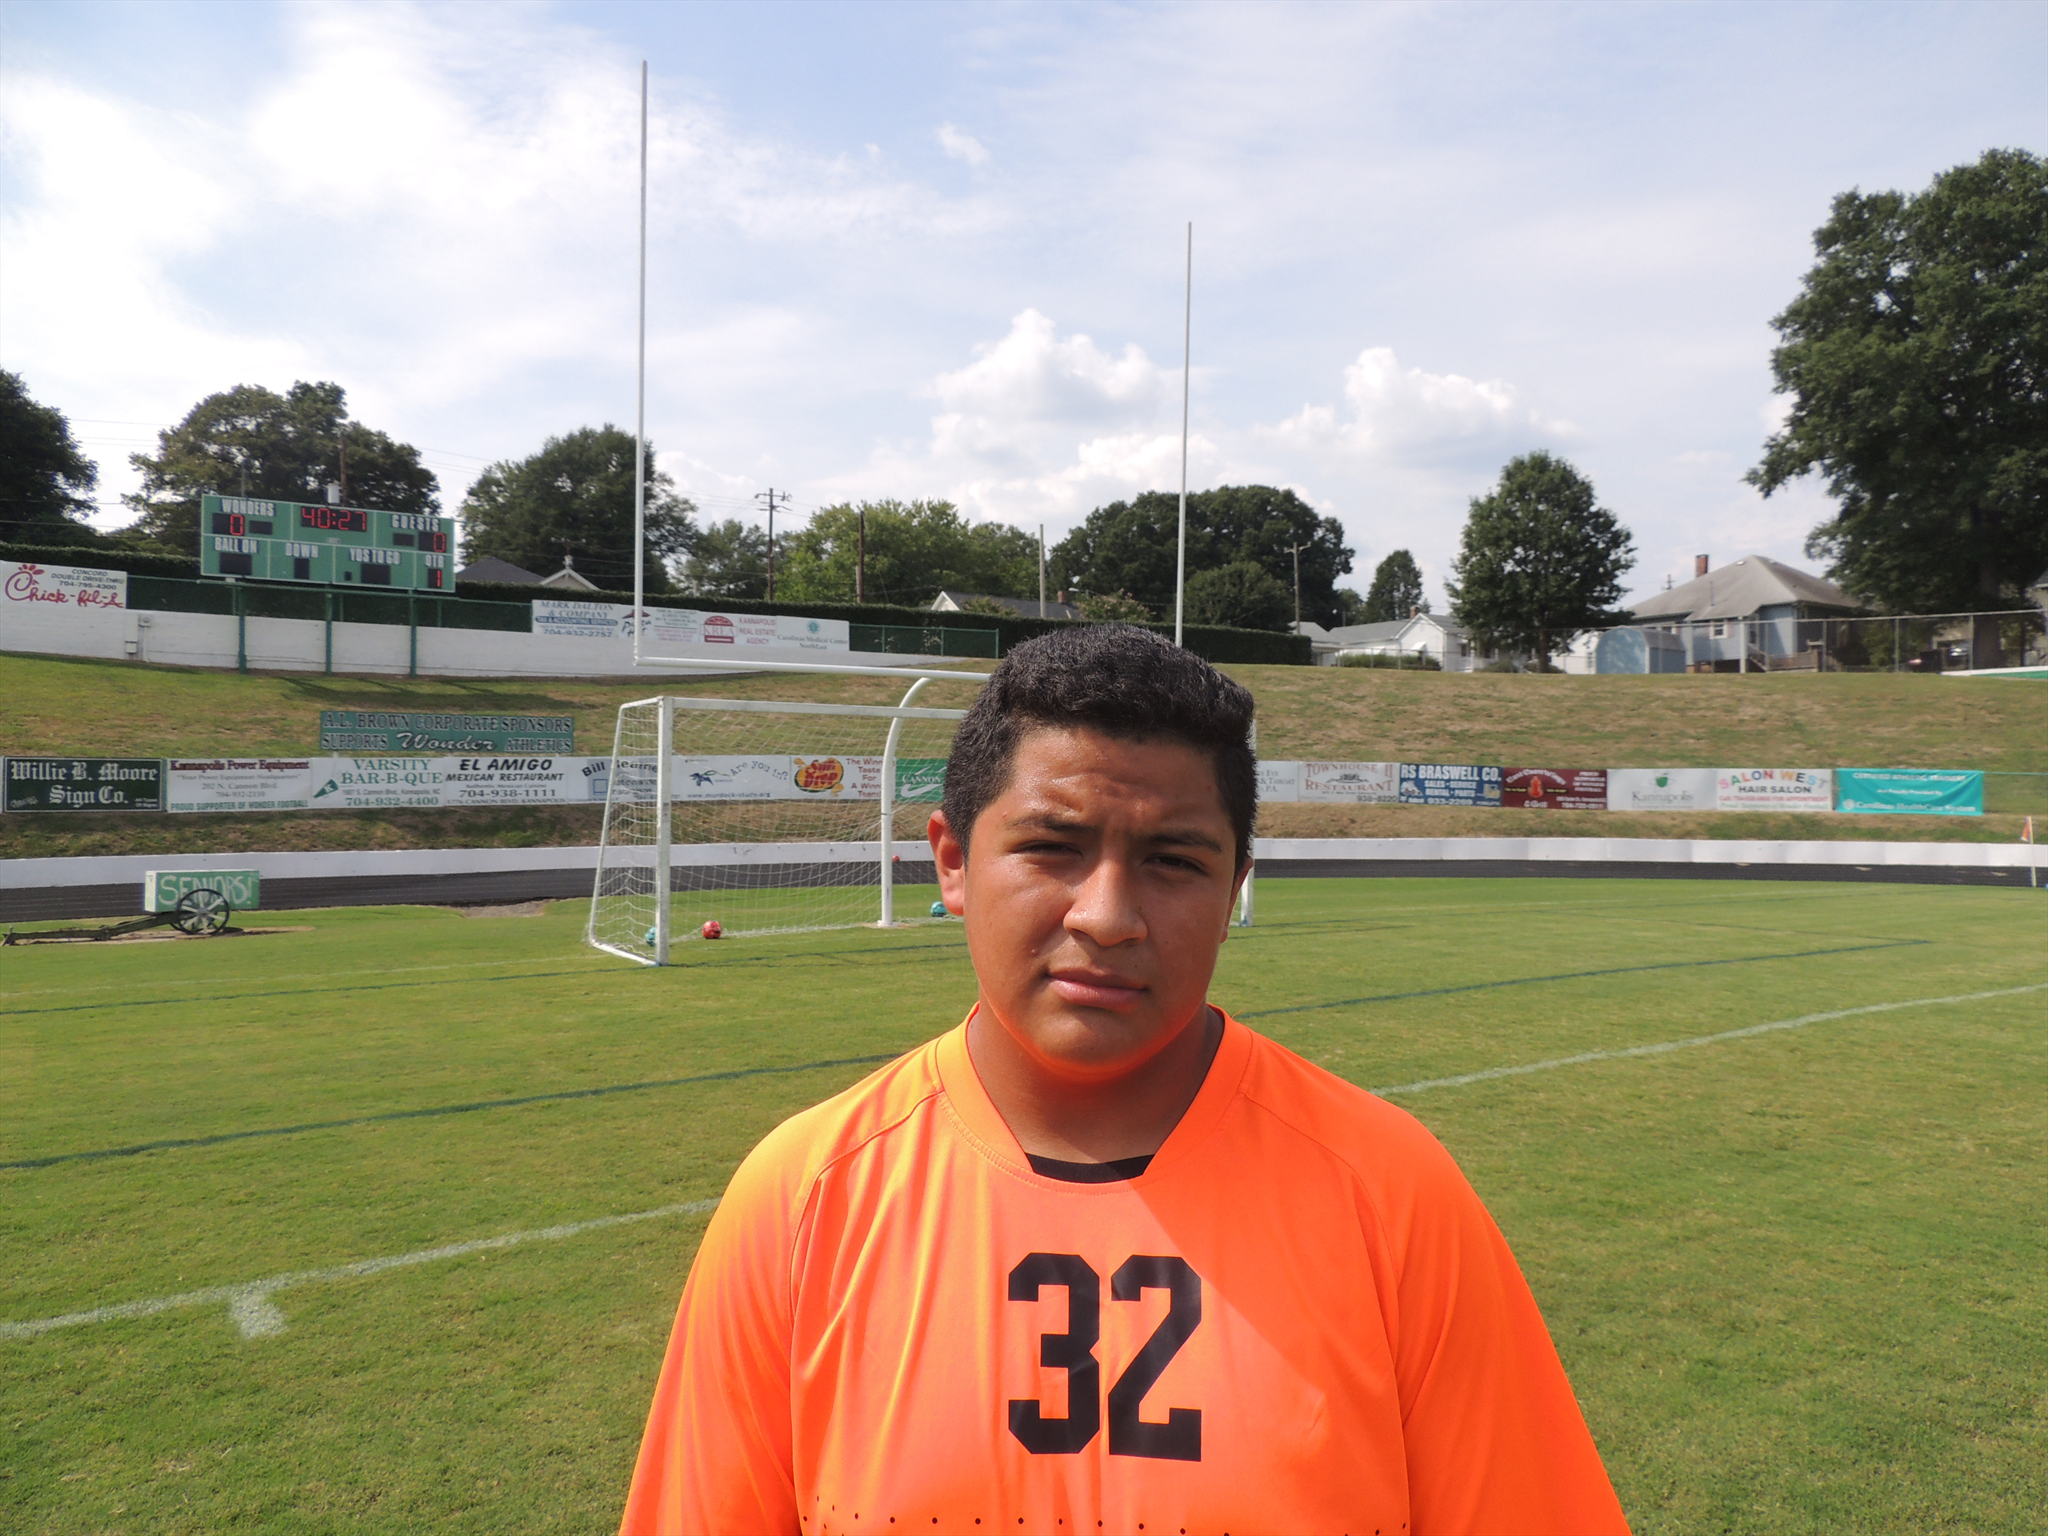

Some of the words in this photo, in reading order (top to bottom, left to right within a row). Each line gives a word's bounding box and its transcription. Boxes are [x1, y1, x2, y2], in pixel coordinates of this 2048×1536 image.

[221, 498, 276, 517] WONDERS
[230, 514, 244, 536] 0
[301, 508, 367, 531] 40:27
[391, 514, 441, 531] GUESTS
[214, 537, 239, 552] BALL
[240, 539, 259, 554] ON
[433, 532, 446, 552] 0
[285, 542, 319, 558] DOWN
[425, 554, 444, 568] QTR
[51, 573, 80, 581] DOUBLE
[71, 569, 108, 577] CONCORD
[5, 568, 124, 608] Chick-fil-A
[541, 600, 570, 609] MARK
[573, 602, 614, 611] DALTON
[559, 610, 608, 619] COMPANY
[621, 619, 651, 634] Piza
[738, 617, 776, 626] KANNAPOLIS
[755, 628, 776, 636] ESTATE
[746, 637, 769, 645] AGENCY
[777, 633, 805, 642] Carolinas
[806, 636, 829, 644] Medical
[830, 637, 848, 645] Center
[356, 713, 411, 730] BROWN
[414, 714, 499, 732] CORPORATE
[501, 717, 572, 733] SPONSORS
[322, 732, 388, 750] SUPPORTS
[396, 731, 498, 751] Wonder
[505, 737, 573, 753] ATHLETICS
[227, 760, 257, 770] Power
[353, 758, 432, 771] VARSITY
[460, 758, 481, 771] EL
[487, 758, 553, 771] AMIGO
[730, 761, 749, 777] Are
[751, 760, 772, 772] you
[846, 758, 863, 766] The
[11, 761, 68, 781] Willie
[98, 763, 159, 781] Moore
[581, 761, 606, 777] Bill
[858, 766, 881, 774] Taste
[1305, 763, 1379, 779] TOWNHOUSE
[1401, 764, 1417, 779] RS
[1418, 765, 1480, 781] BRASWELL
[1481, 766, 1502, 782] CO.
[341, 772, 444, 786] BAR-B-QUE
[446, 773, 494, 782] MEXICAN
[499, 773, 565, 782] RESTAURANT
[863, 774, 877, 782] For
[901, 773, 941, 784] CANNON
[1718, 770, 1774, 789] SALON
[1780, 770, 1830, 789] WEST
[228, 782, 259, 790] Cannon
[1305, 778, 1394, 791] RESTAURANT
[1738, 785, 1768, 794] HAIR
[1770, 785, 1813, 794] SALON
[49, 784, 95, 808] Sign
[98, 785, 130, 805] Co.
[459, 789, 556, 799] 704-938-1111
[171, 803, 195, 811] PROUD
[197, 802, 236, 811] SUPPORTER
[238, 802, 247, 810] OF
[249, 801, 276, 810] WONDER
[278, 800, 309, 809] FOOTBALL
[345, 797, 439, 807] 704-932-4400
[1857, 800, 1895, 810] Carolinas
[1944, 804, 1977, 814] System
[1008, 1252, 1202, 1462] 32
